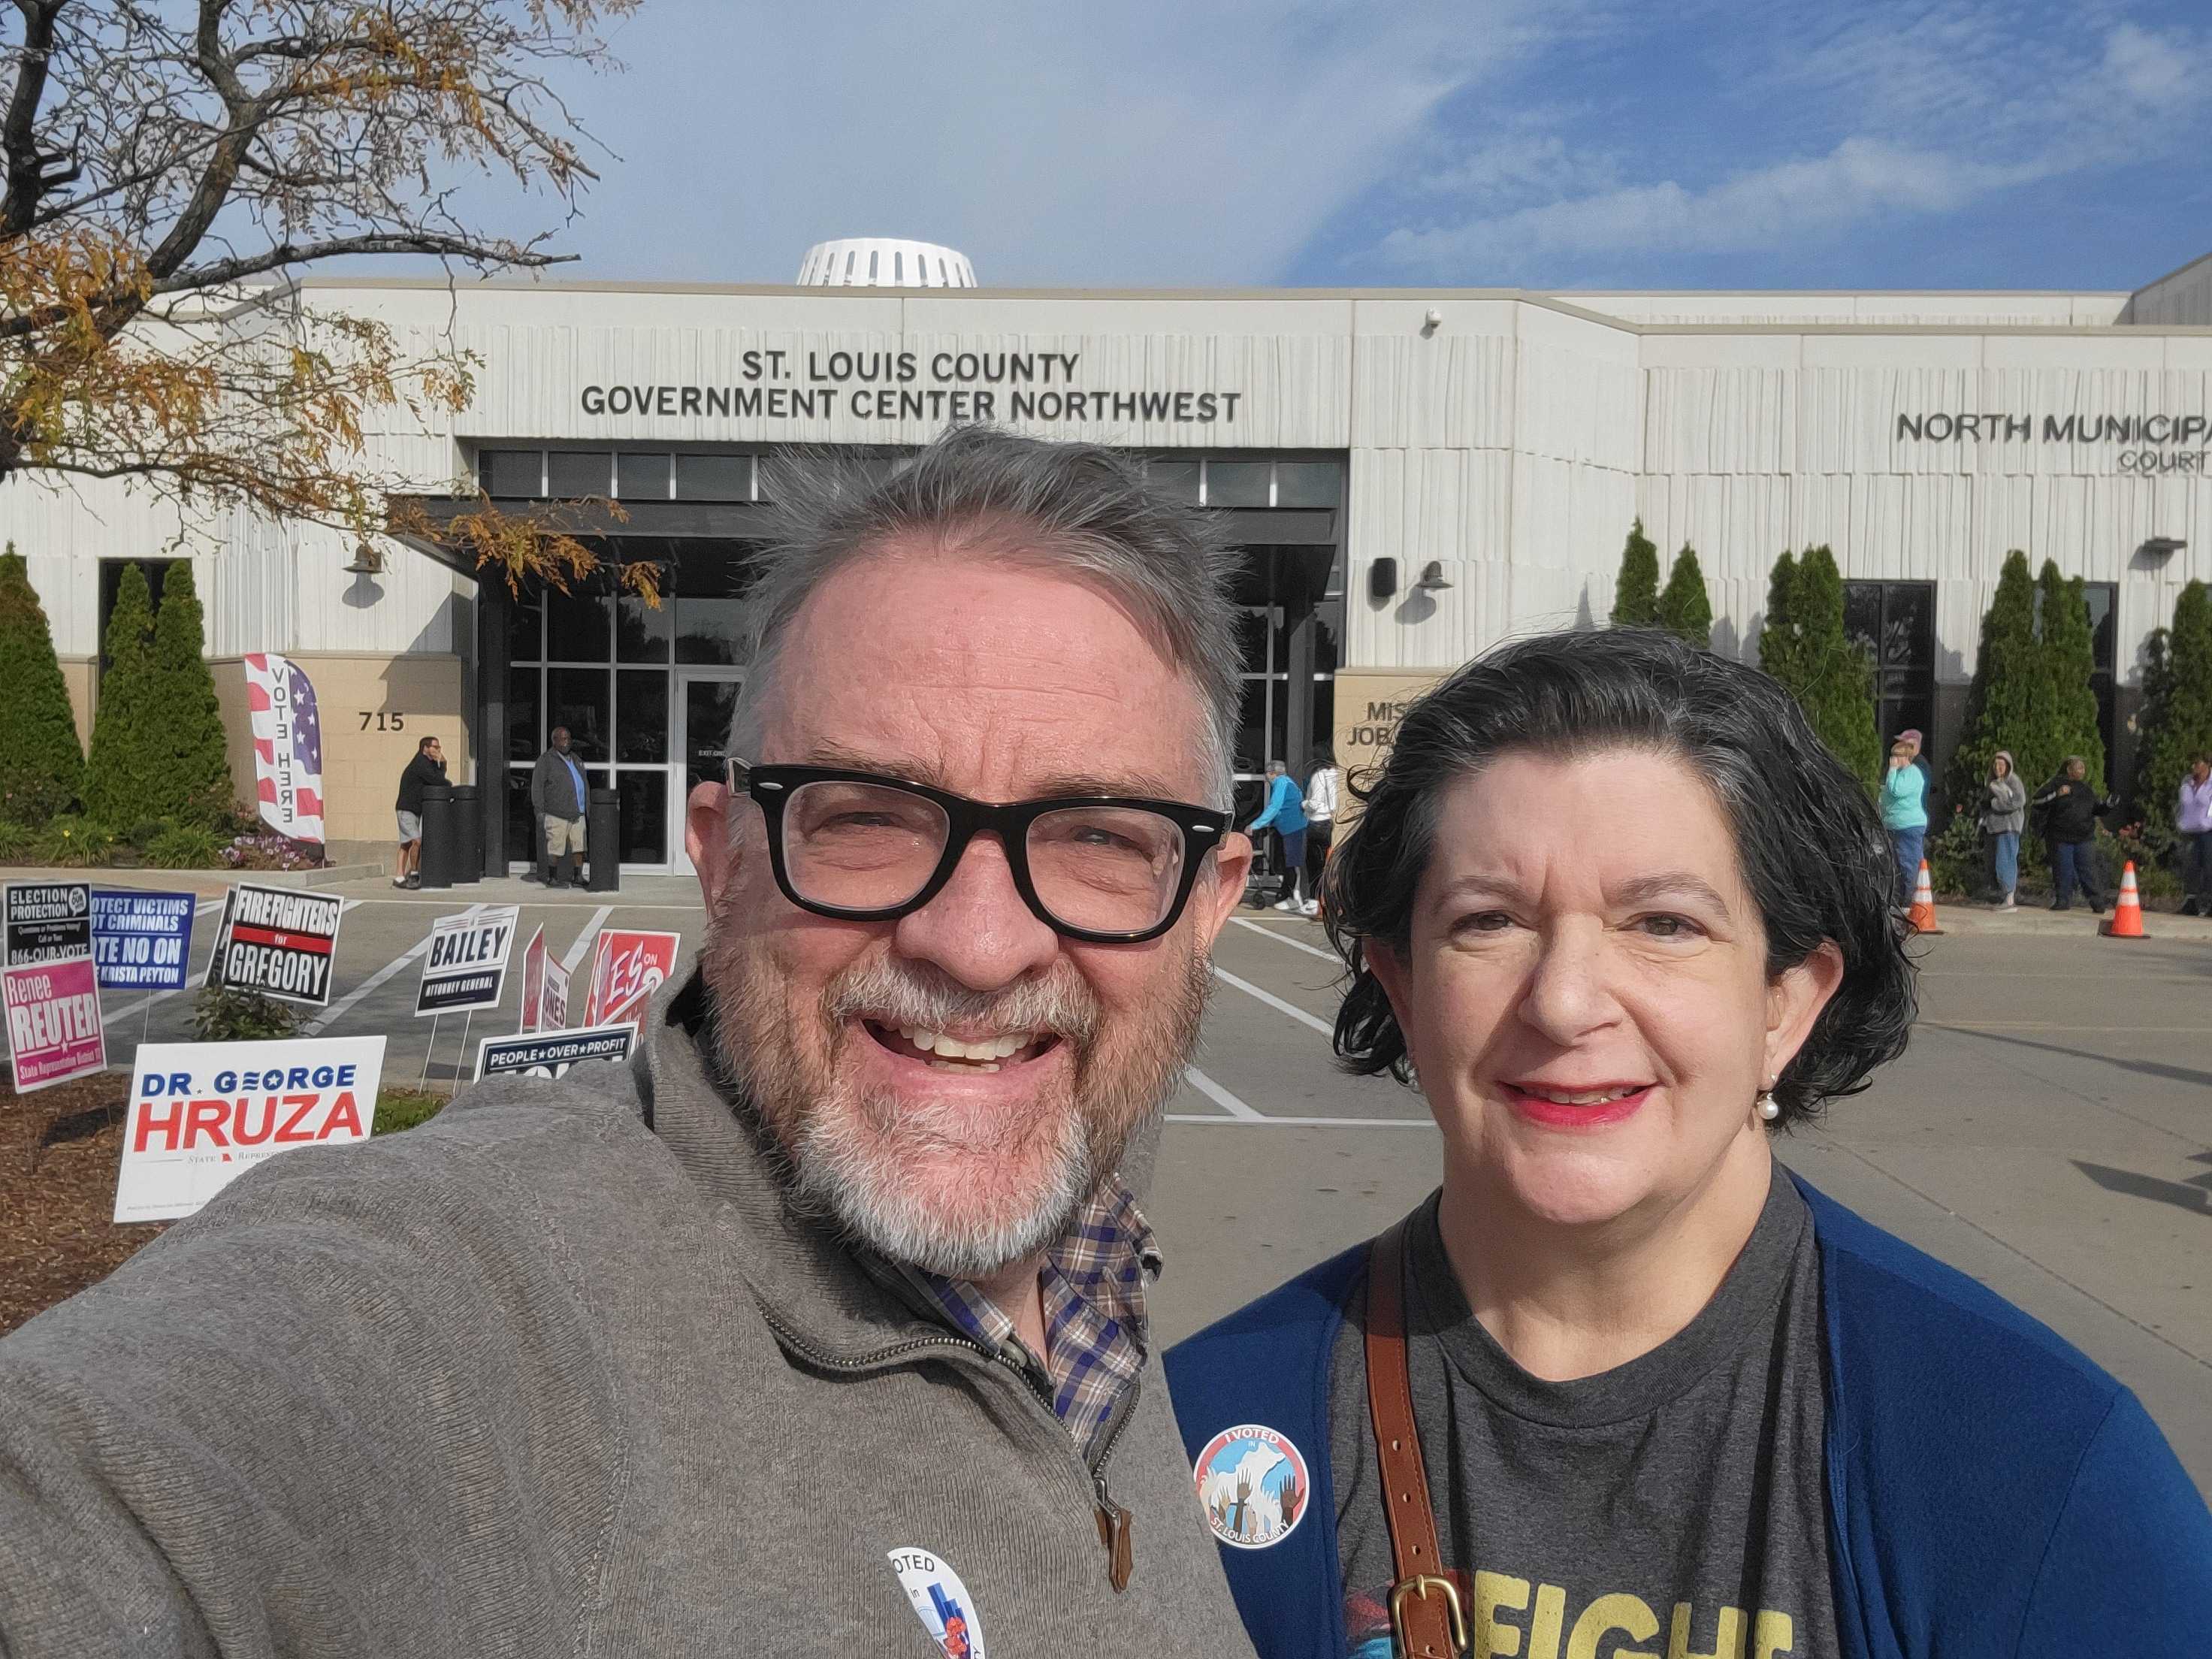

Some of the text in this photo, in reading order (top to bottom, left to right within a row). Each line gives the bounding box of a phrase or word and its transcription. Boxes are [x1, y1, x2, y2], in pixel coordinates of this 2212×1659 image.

[742, 351, 1079, 384] ST. LOUIS COUNTY
[582, 385, 1241, 423] GOVERNMENT CENTER NORTHWEST
[1897, 412, 2031, 443] NORTH
[358, 712, 404, 732] 715
[10, 888, 68, 905] ELECTION
[91, 897, 131, 914] OTECT
[132, 898, 189, 916] VICTIMS
[11, 903, 68, 920] PROTECTION
[91, 914, 106, 930] OT
[107, 914, 180, 932] CRIMINALS
[234, 889, 338, 936] FIREFIGHTERS
[92, 936, 120, 963] TE
[122, 937, 150, 965] NO
[153, 937, 182, 965] ON
[273, 933, 287, 945] for
[429, 925, 509, 969] BAILEY
[228, 943, 328, 996] GREGORY
[603, 939, 644, 1005] ES
[643, 953, 658, 966] ON
[100, 965, 138, 983] KRISTA
[138, 966, 180, 984] PEYTON
[425, 976, 494, 998] ATTORNEY GENERAL
[6, 975, 53, 1005] Renee
[545, 986, 566, 1026] ONES
[11, 993, 98, 1052] REUTER
[491, 1038, 627, 1066] PEOPLE OVER PROFIT
[213, 1064, 357, 1094] GEORGE
[133, 1091, 364, 1153] HRUZA
[1234, 1428, 1280, 1445] VOTED
[1210, 1516, 1290, 1543] ST. LOUIS COUNTY
[892, 1555, 935, 1574] OTED
[909, 1588, 920, 1599] in
